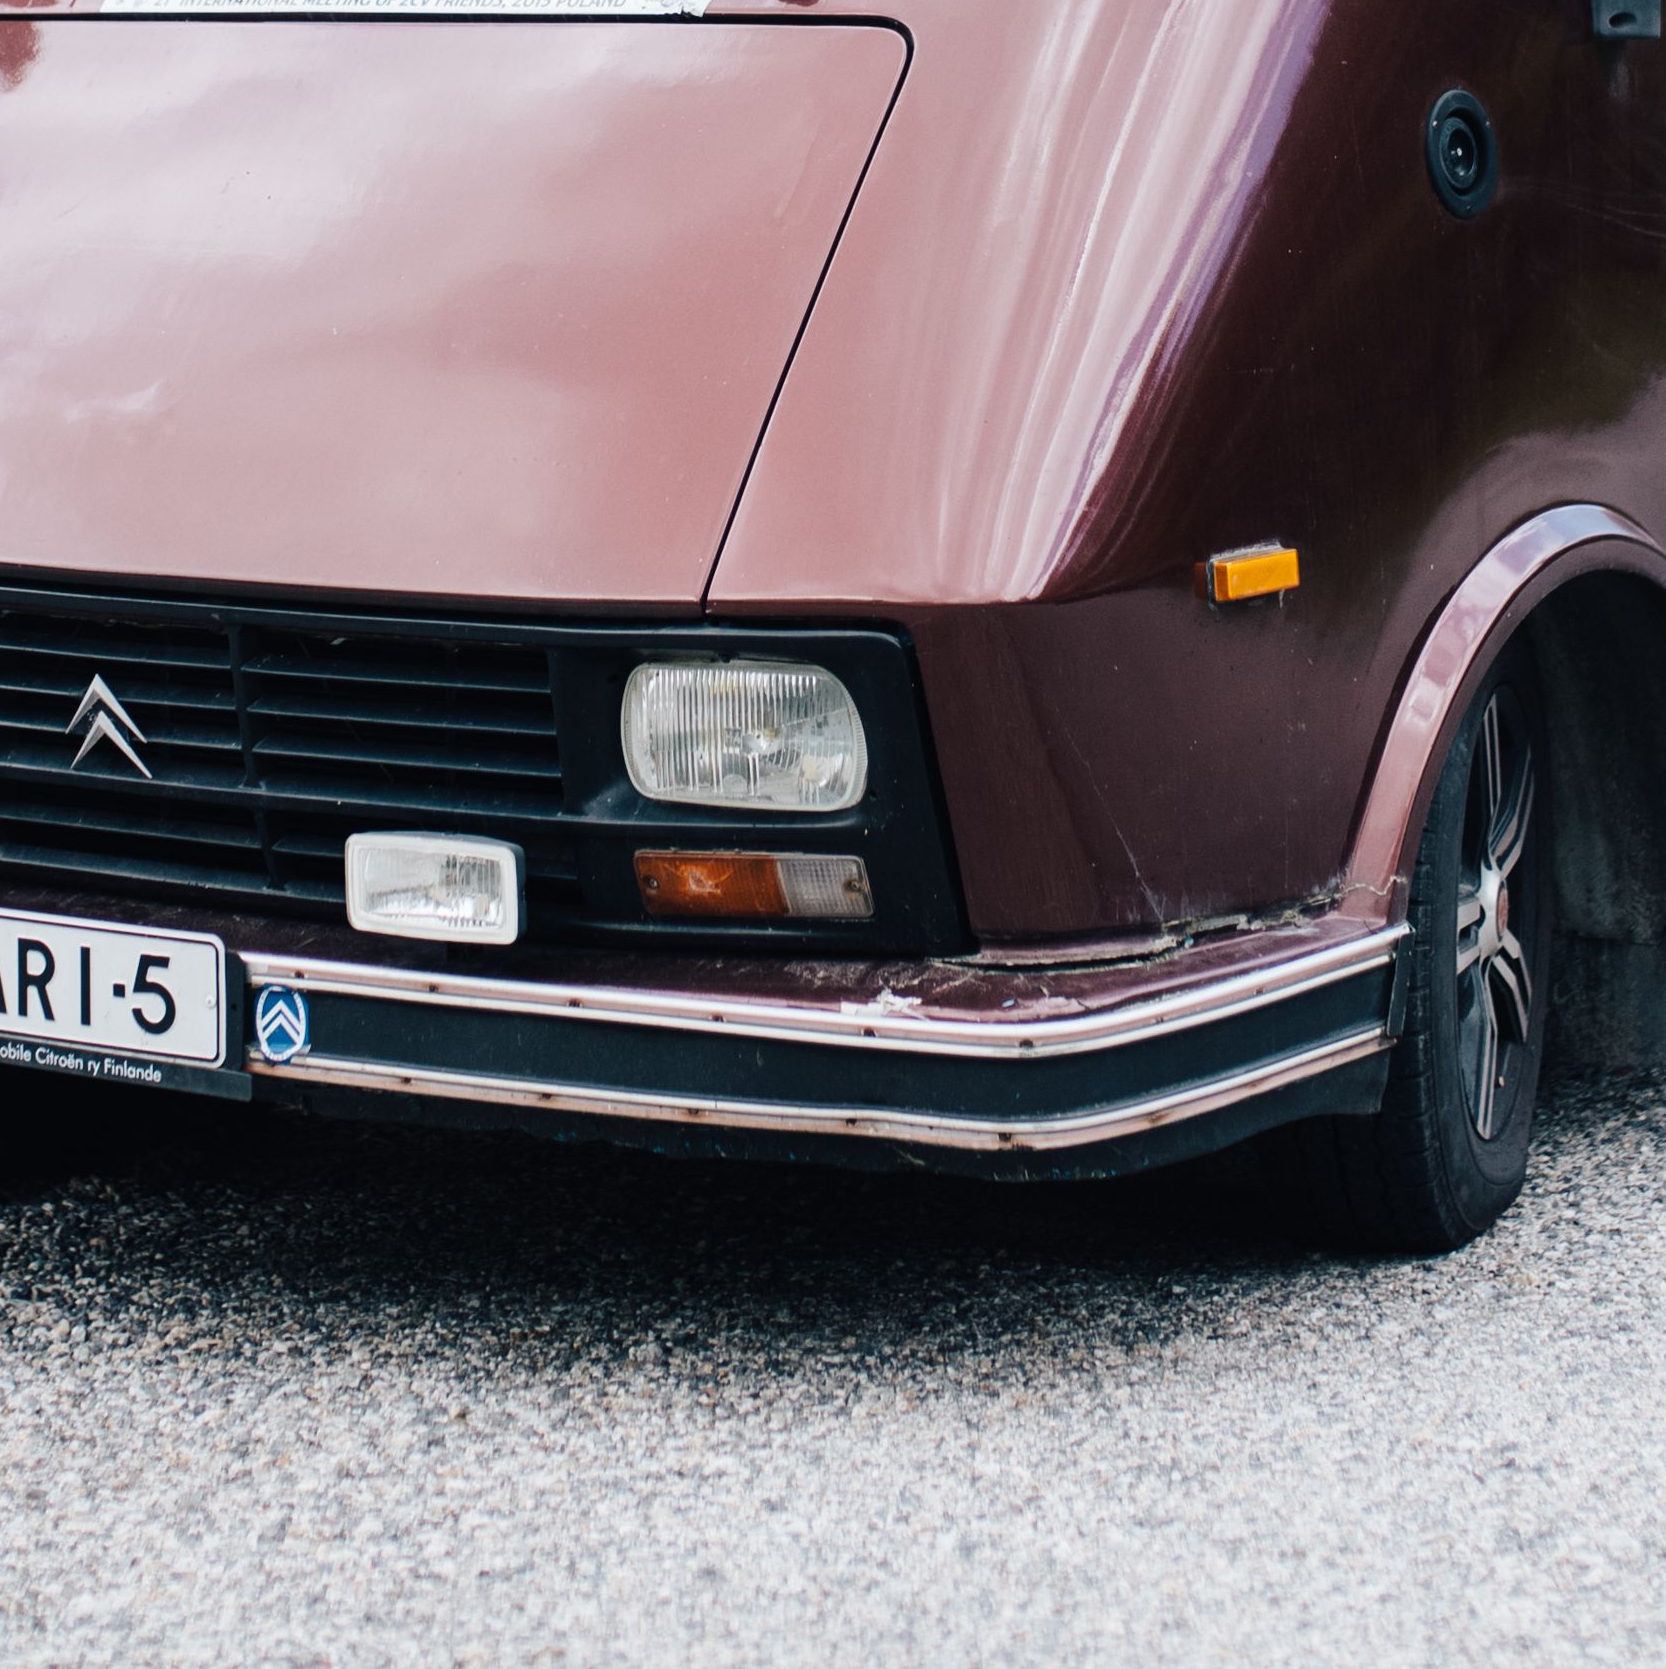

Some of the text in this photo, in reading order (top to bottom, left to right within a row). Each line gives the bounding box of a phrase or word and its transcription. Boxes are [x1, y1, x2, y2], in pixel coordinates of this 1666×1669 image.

[35, 1046, 84, 1071] Citroën
[87, 1060, 102, 1076] ry
[104, 1057, 162, 1083] Finlande
